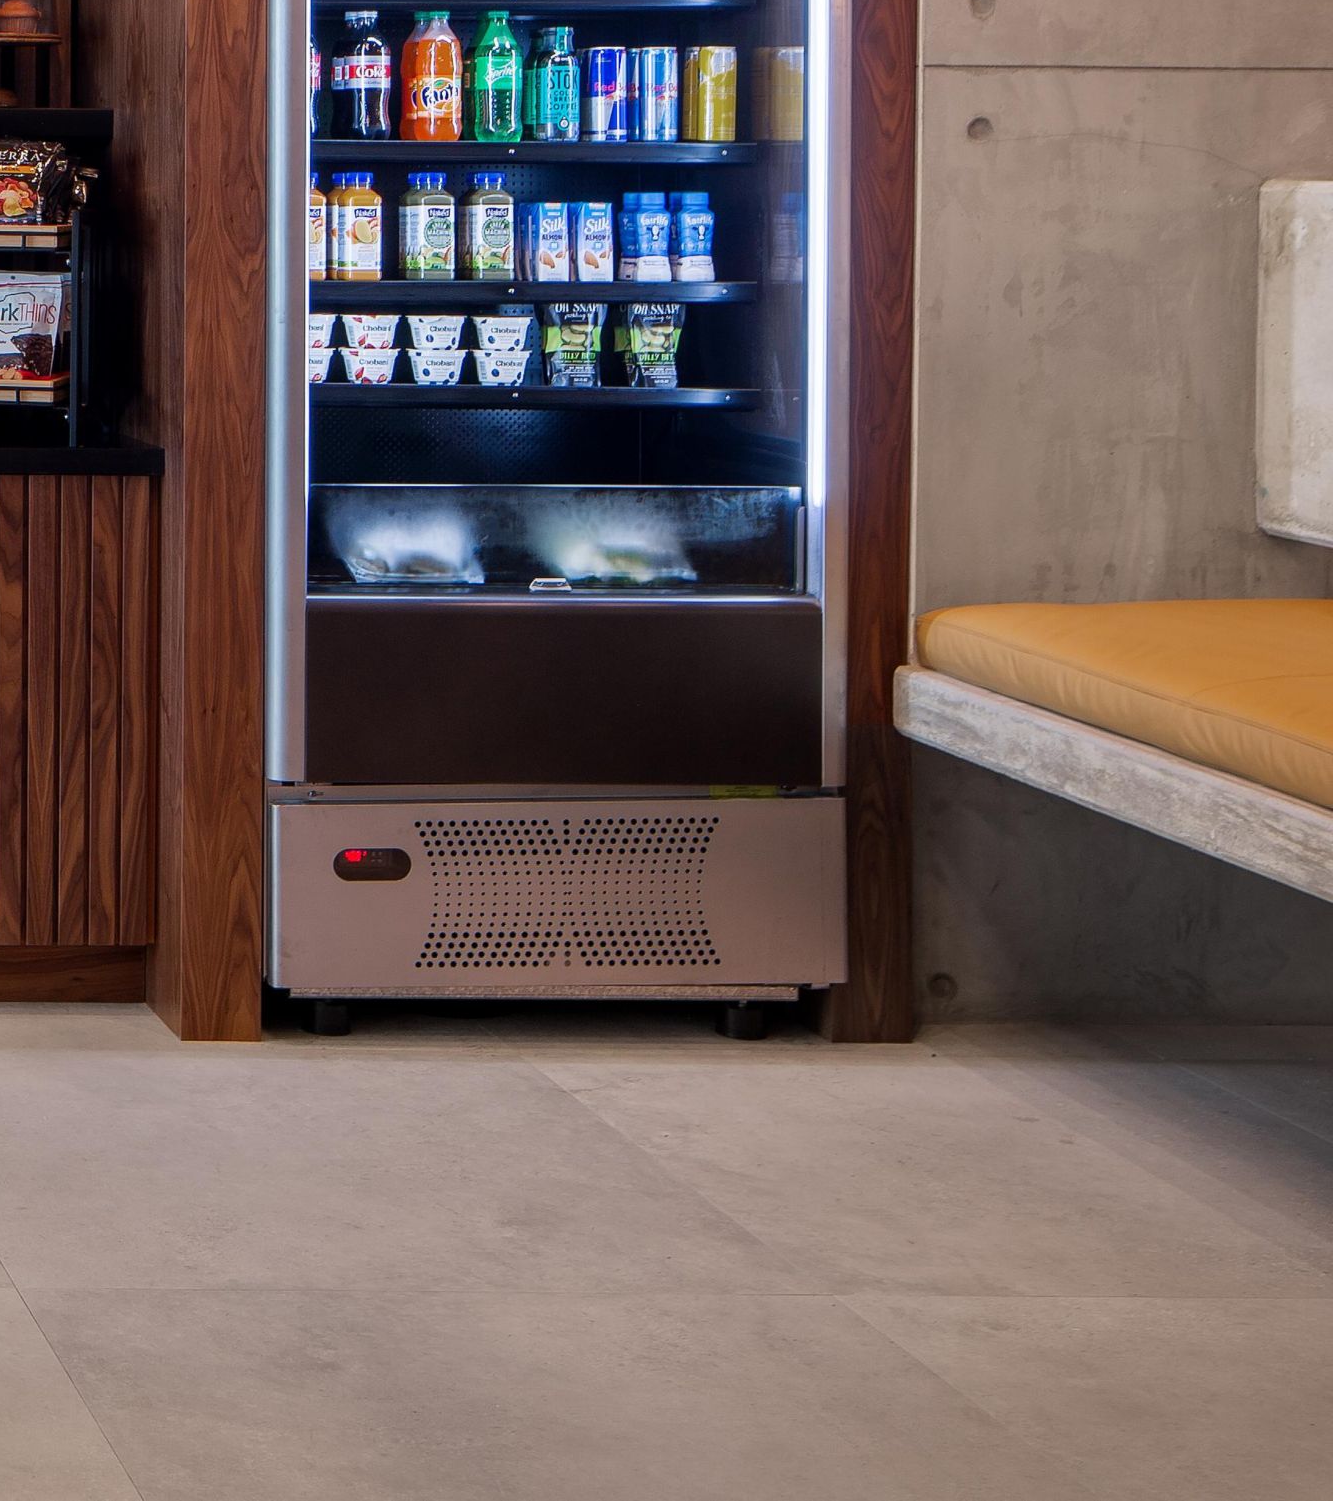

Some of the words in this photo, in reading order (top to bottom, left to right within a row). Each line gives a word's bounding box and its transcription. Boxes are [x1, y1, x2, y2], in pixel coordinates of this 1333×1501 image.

[356, 65, 387, 78] Coke
[540, 216, 566, 234] Silk
[584, 216, 610, 234] Silk
